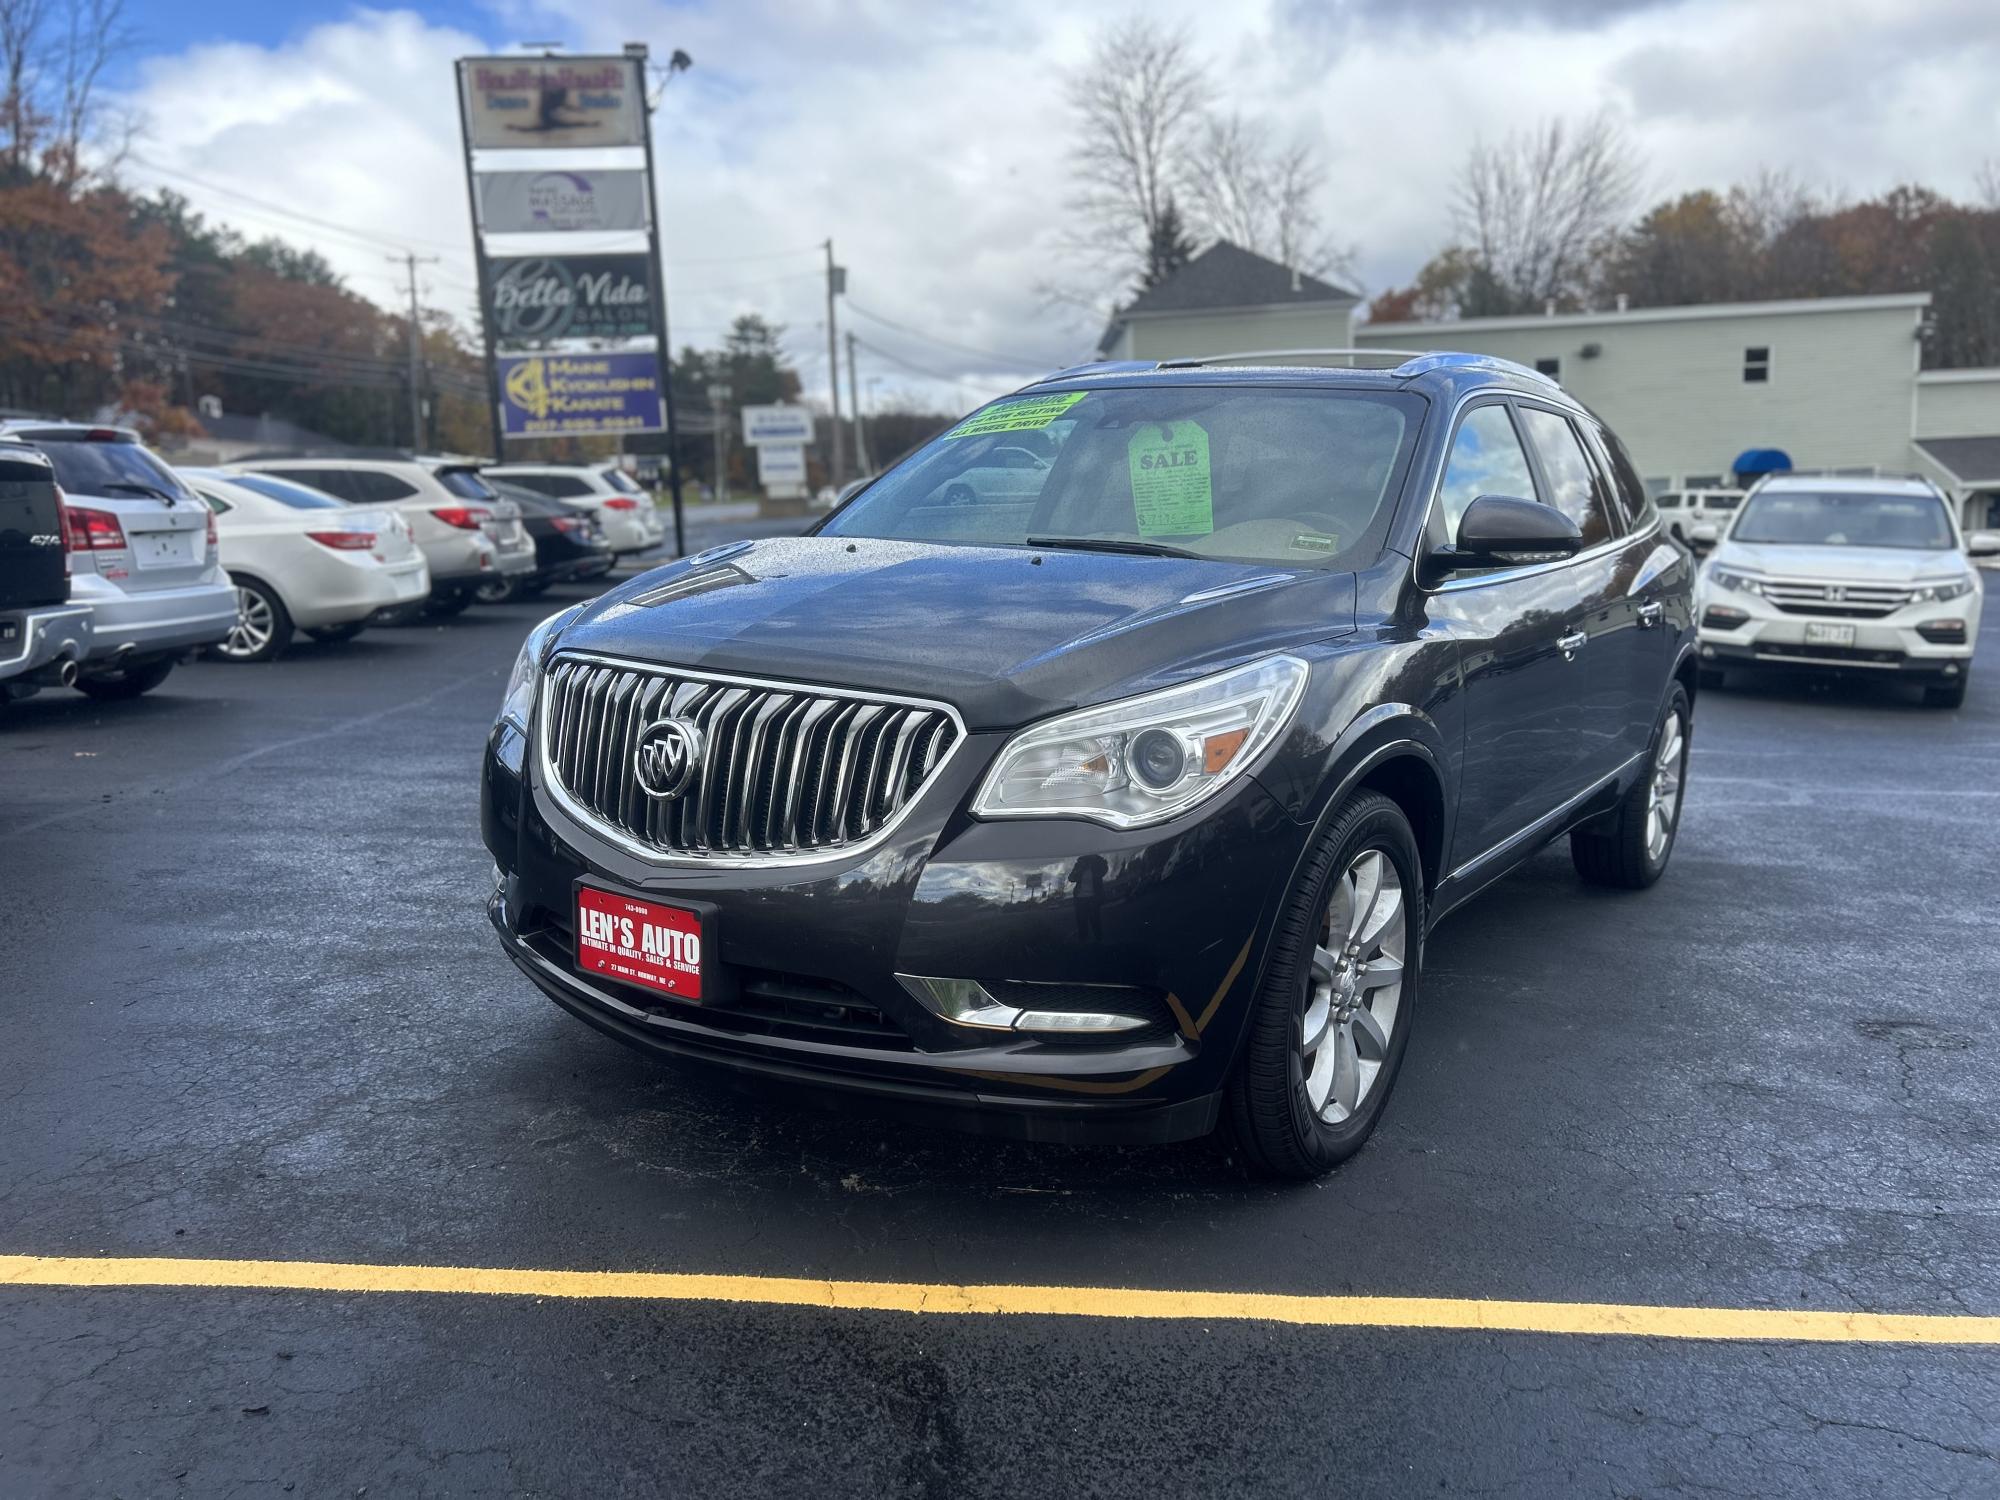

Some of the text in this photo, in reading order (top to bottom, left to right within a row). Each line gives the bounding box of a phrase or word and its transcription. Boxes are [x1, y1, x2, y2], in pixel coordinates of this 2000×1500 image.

[577, 271, 649, 306] Vida
[576, 307, 649, 322] SALON
[1012, 405, 1069, 418] SEATING
[971, 422, 1009, 433] WHEEL
[1010, 418, 1052, 429] DRIVE
[1140, 450, 1198, 470] SALE
[580, 906, 700, 965] LEN'S AUTO
[581, 936, 700, 975] ULTIMATE IN QUALITY, SALES & SERVICE
